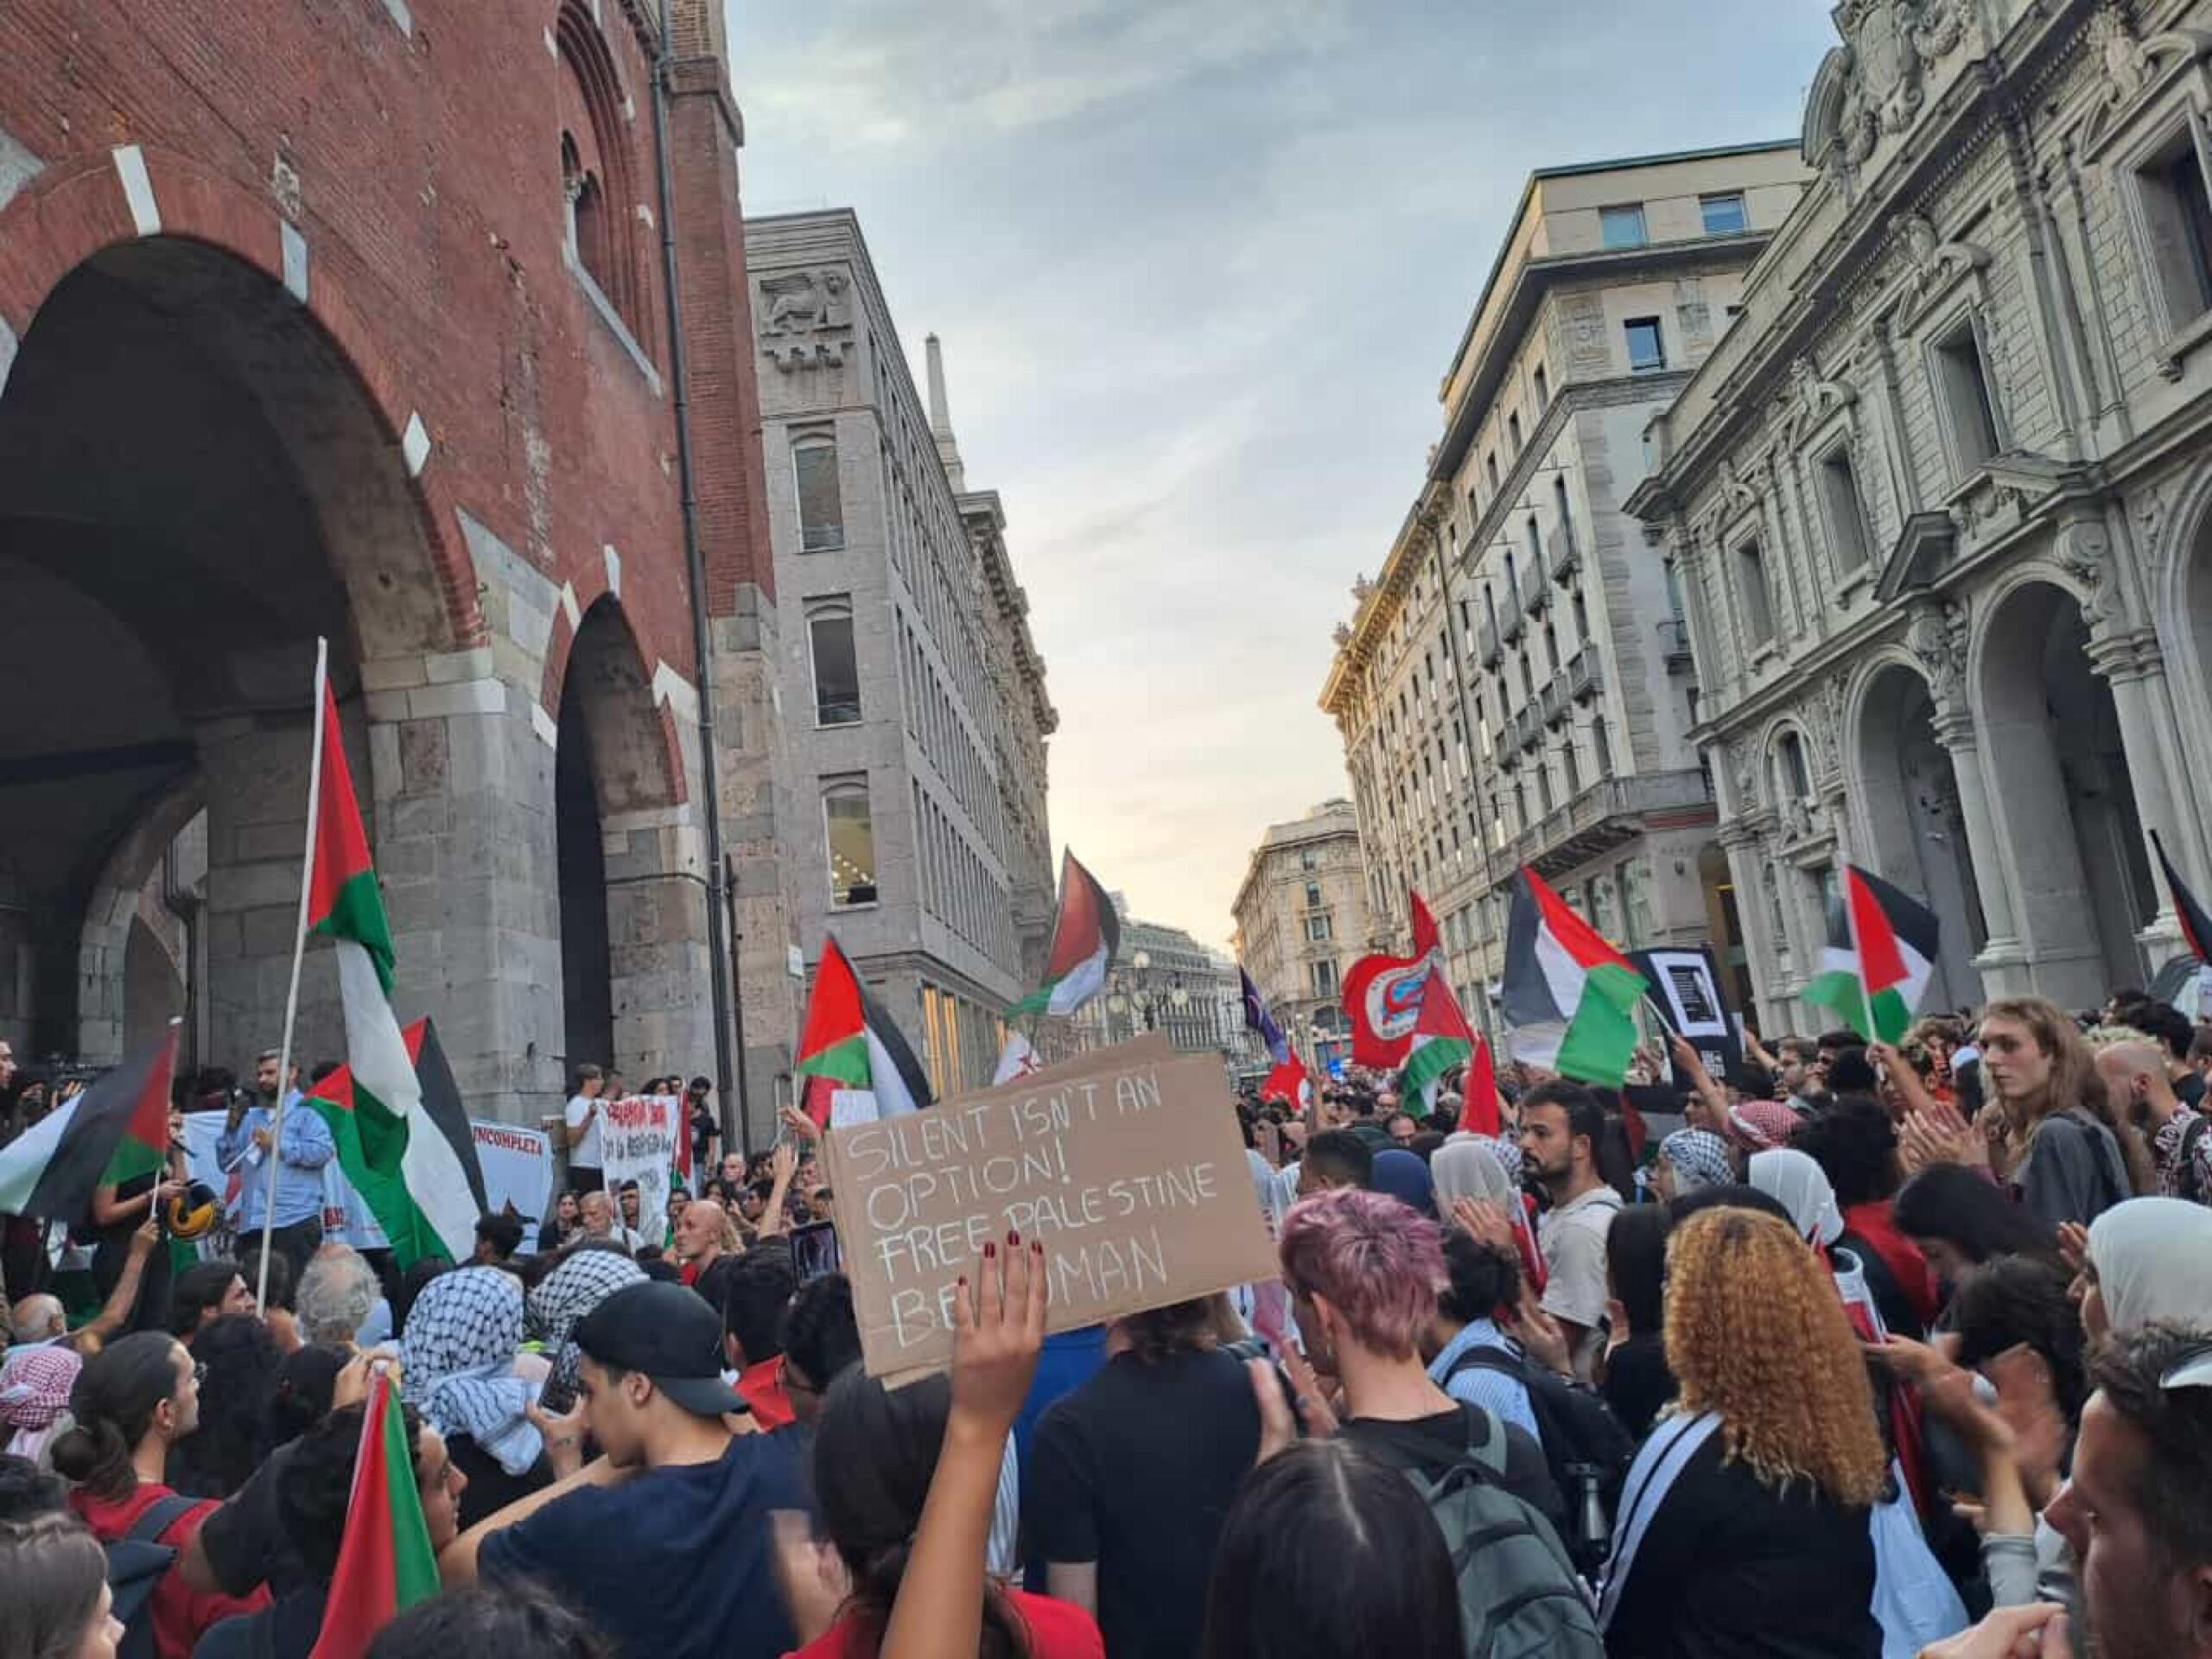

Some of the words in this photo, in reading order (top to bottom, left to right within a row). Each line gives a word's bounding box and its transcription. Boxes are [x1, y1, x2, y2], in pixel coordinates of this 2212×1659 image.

[845, 1104, 991, 1181] SILENT
[1008, 1081, 1099, 1141] ISN'T
[1116, 1068, 1163, 1116] AN
[867, 1135, 1072, 1231] OPTION!
[874, 1213, 991, 1284] FREE
[1002, 1161, 1218, 1237] PALESTINE
